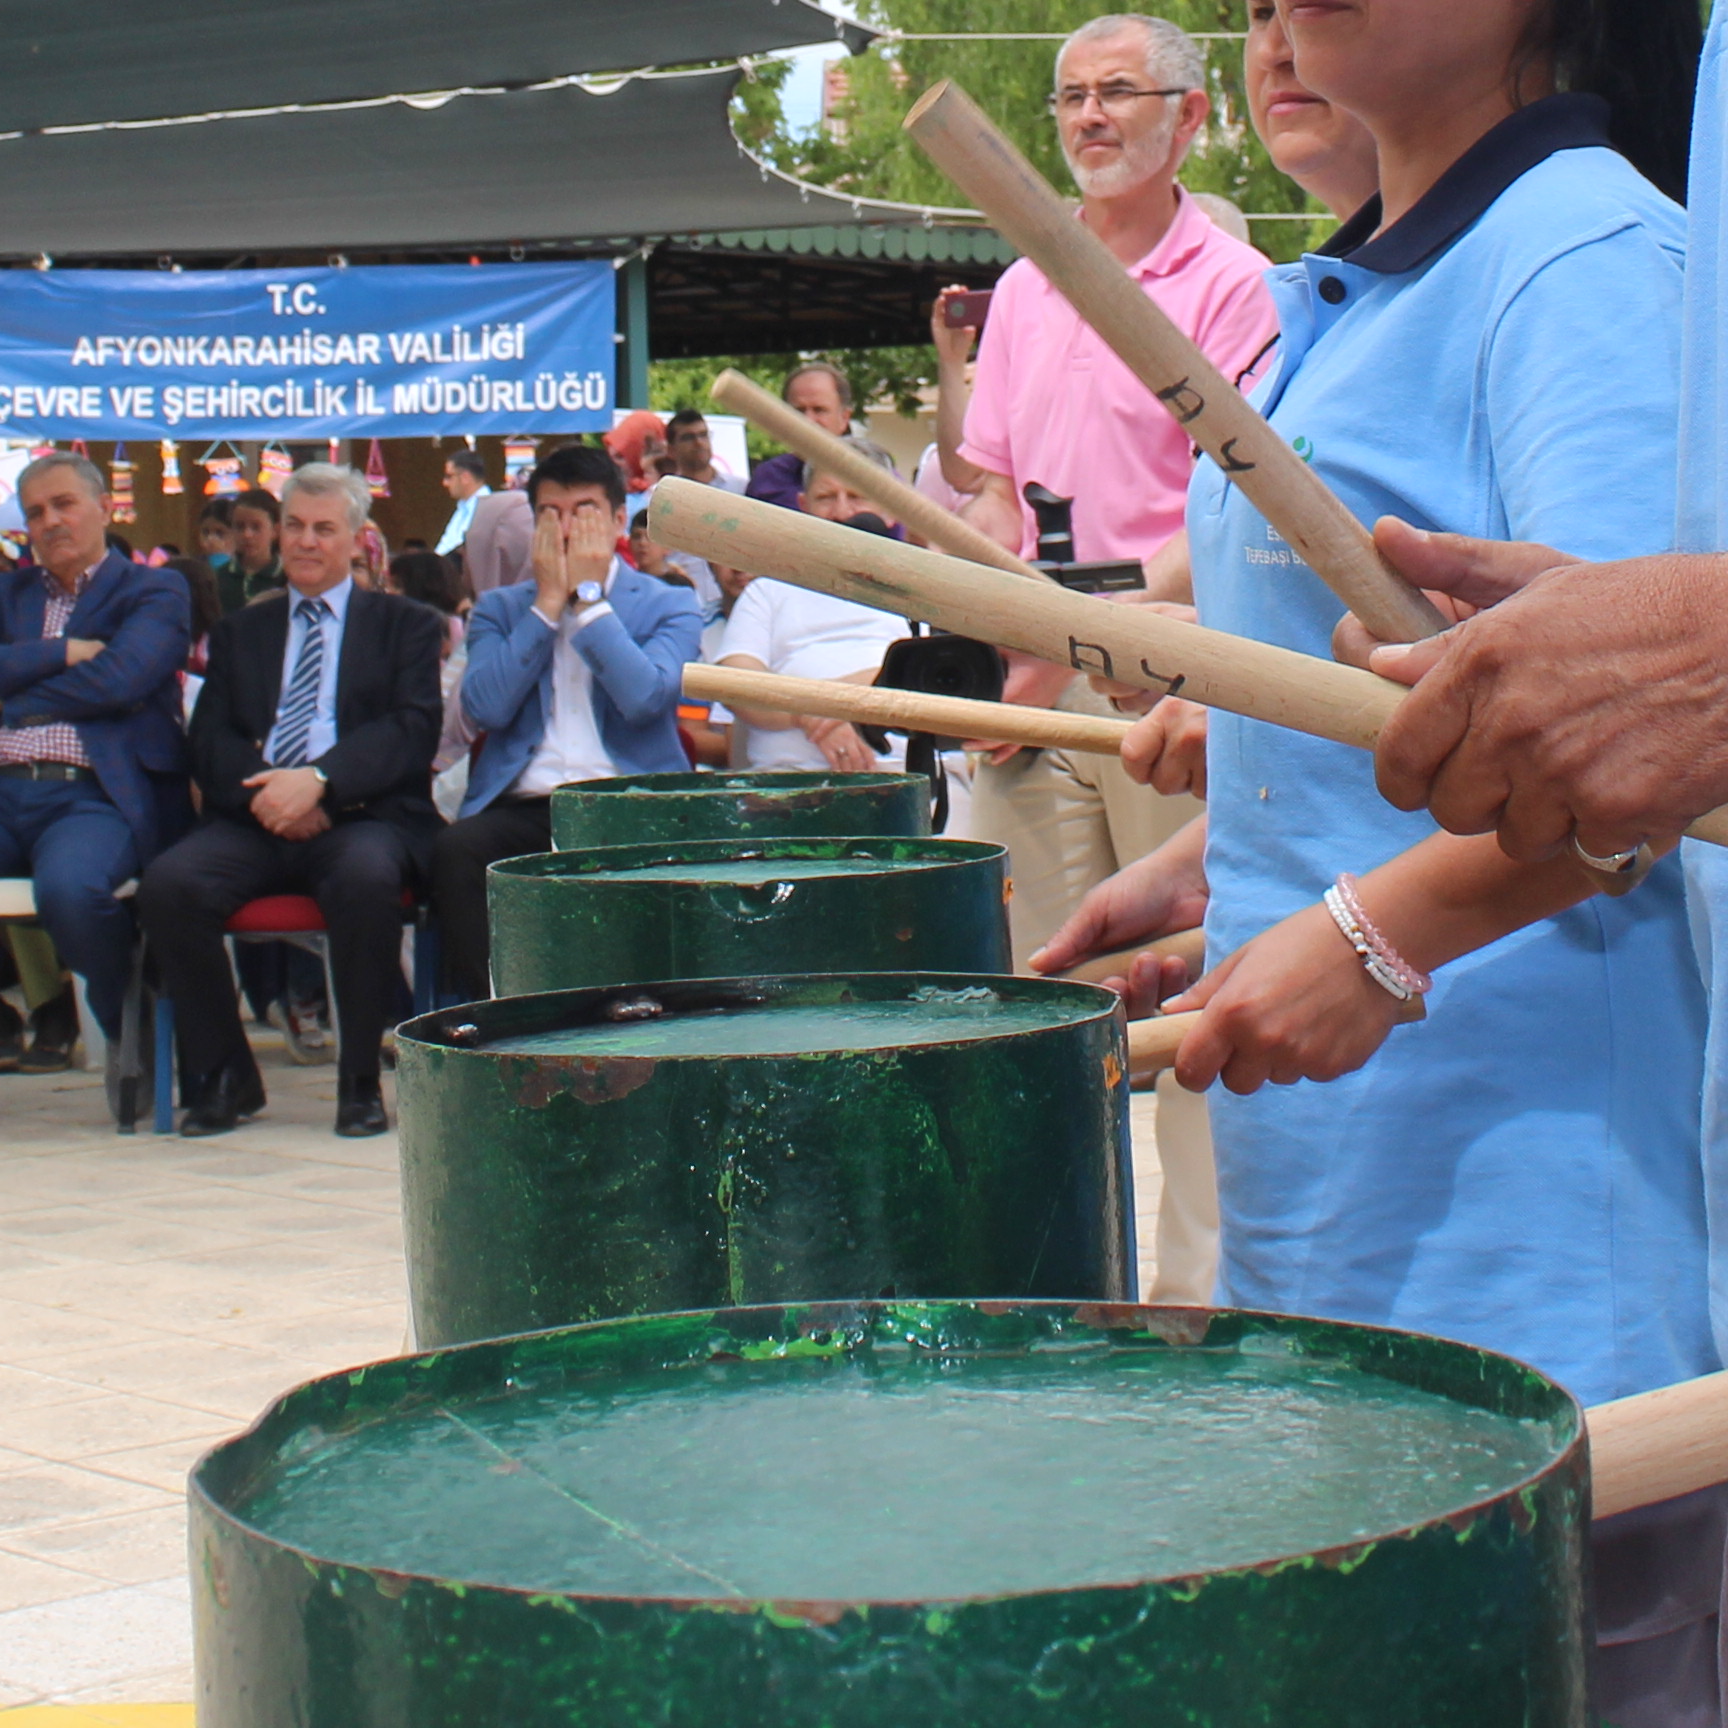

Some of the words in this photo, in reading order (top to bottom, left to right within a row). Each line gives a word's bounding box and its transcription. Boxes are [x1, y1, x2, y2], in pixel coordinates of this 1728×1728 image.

[266, 283, 327, 315] T.C.
[71, 328, 381, 366] AFYONKARAHİSAR
[388, 322, 526, 364] VALİLİĞİ
[109, 385, 155, 418] VE
[161, 378, 348, 425] ŞEHİRCİLİK
[356, 378, 386, 416] İL
[393, 370, 607, 416] MÜDÜRLÜĞÜ
